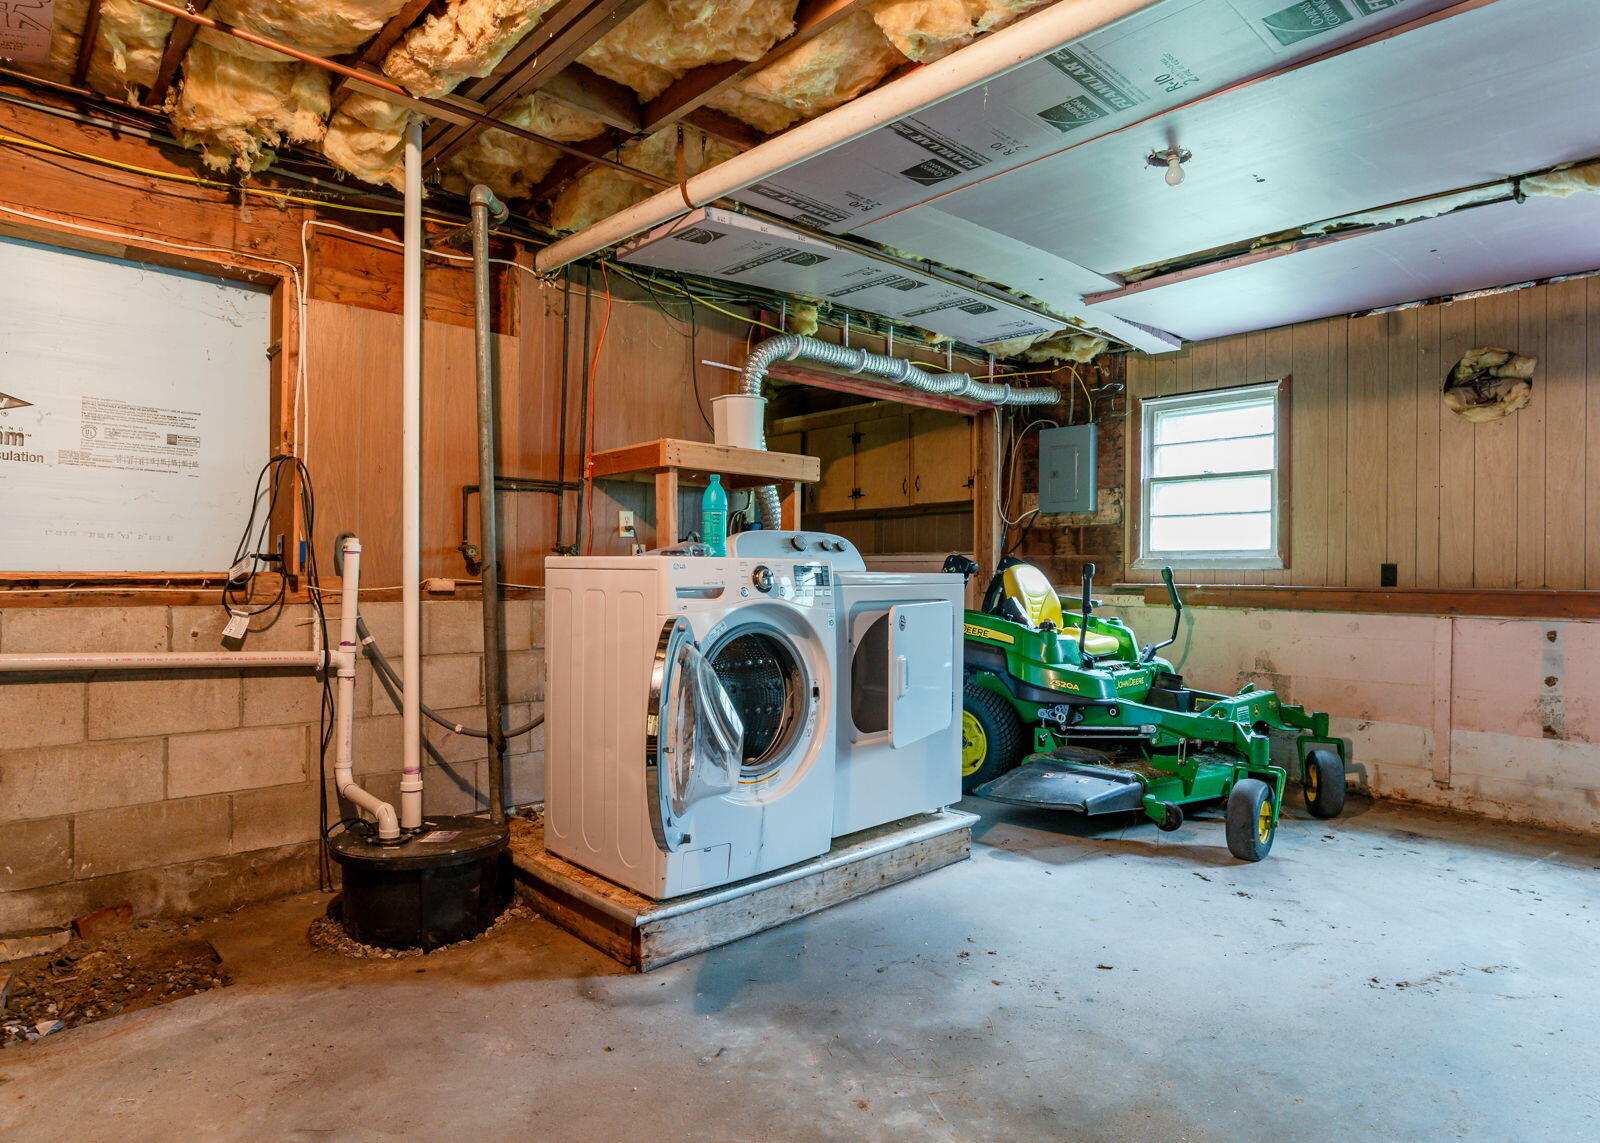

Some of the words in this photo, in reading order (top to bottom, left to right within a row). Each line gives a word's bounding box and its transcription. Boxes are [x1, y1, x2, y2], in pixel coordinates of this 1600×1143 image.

[1301, 2, 1324, 25] OWENS
[1063, 61, 1132, 108] FOAMULAR
[1153, 73, 1183, 93] R-10
[1061, 101, 1087, 120] OWENS
[1070, 99, 1100, 119] CORNING
[912, 134, 980, 169] FOAMULAR
[990, 142, 1016, 156] R-10
[780, 197, 847, 221] FOAMULAR
[0, 451, 44, 463] ulation
